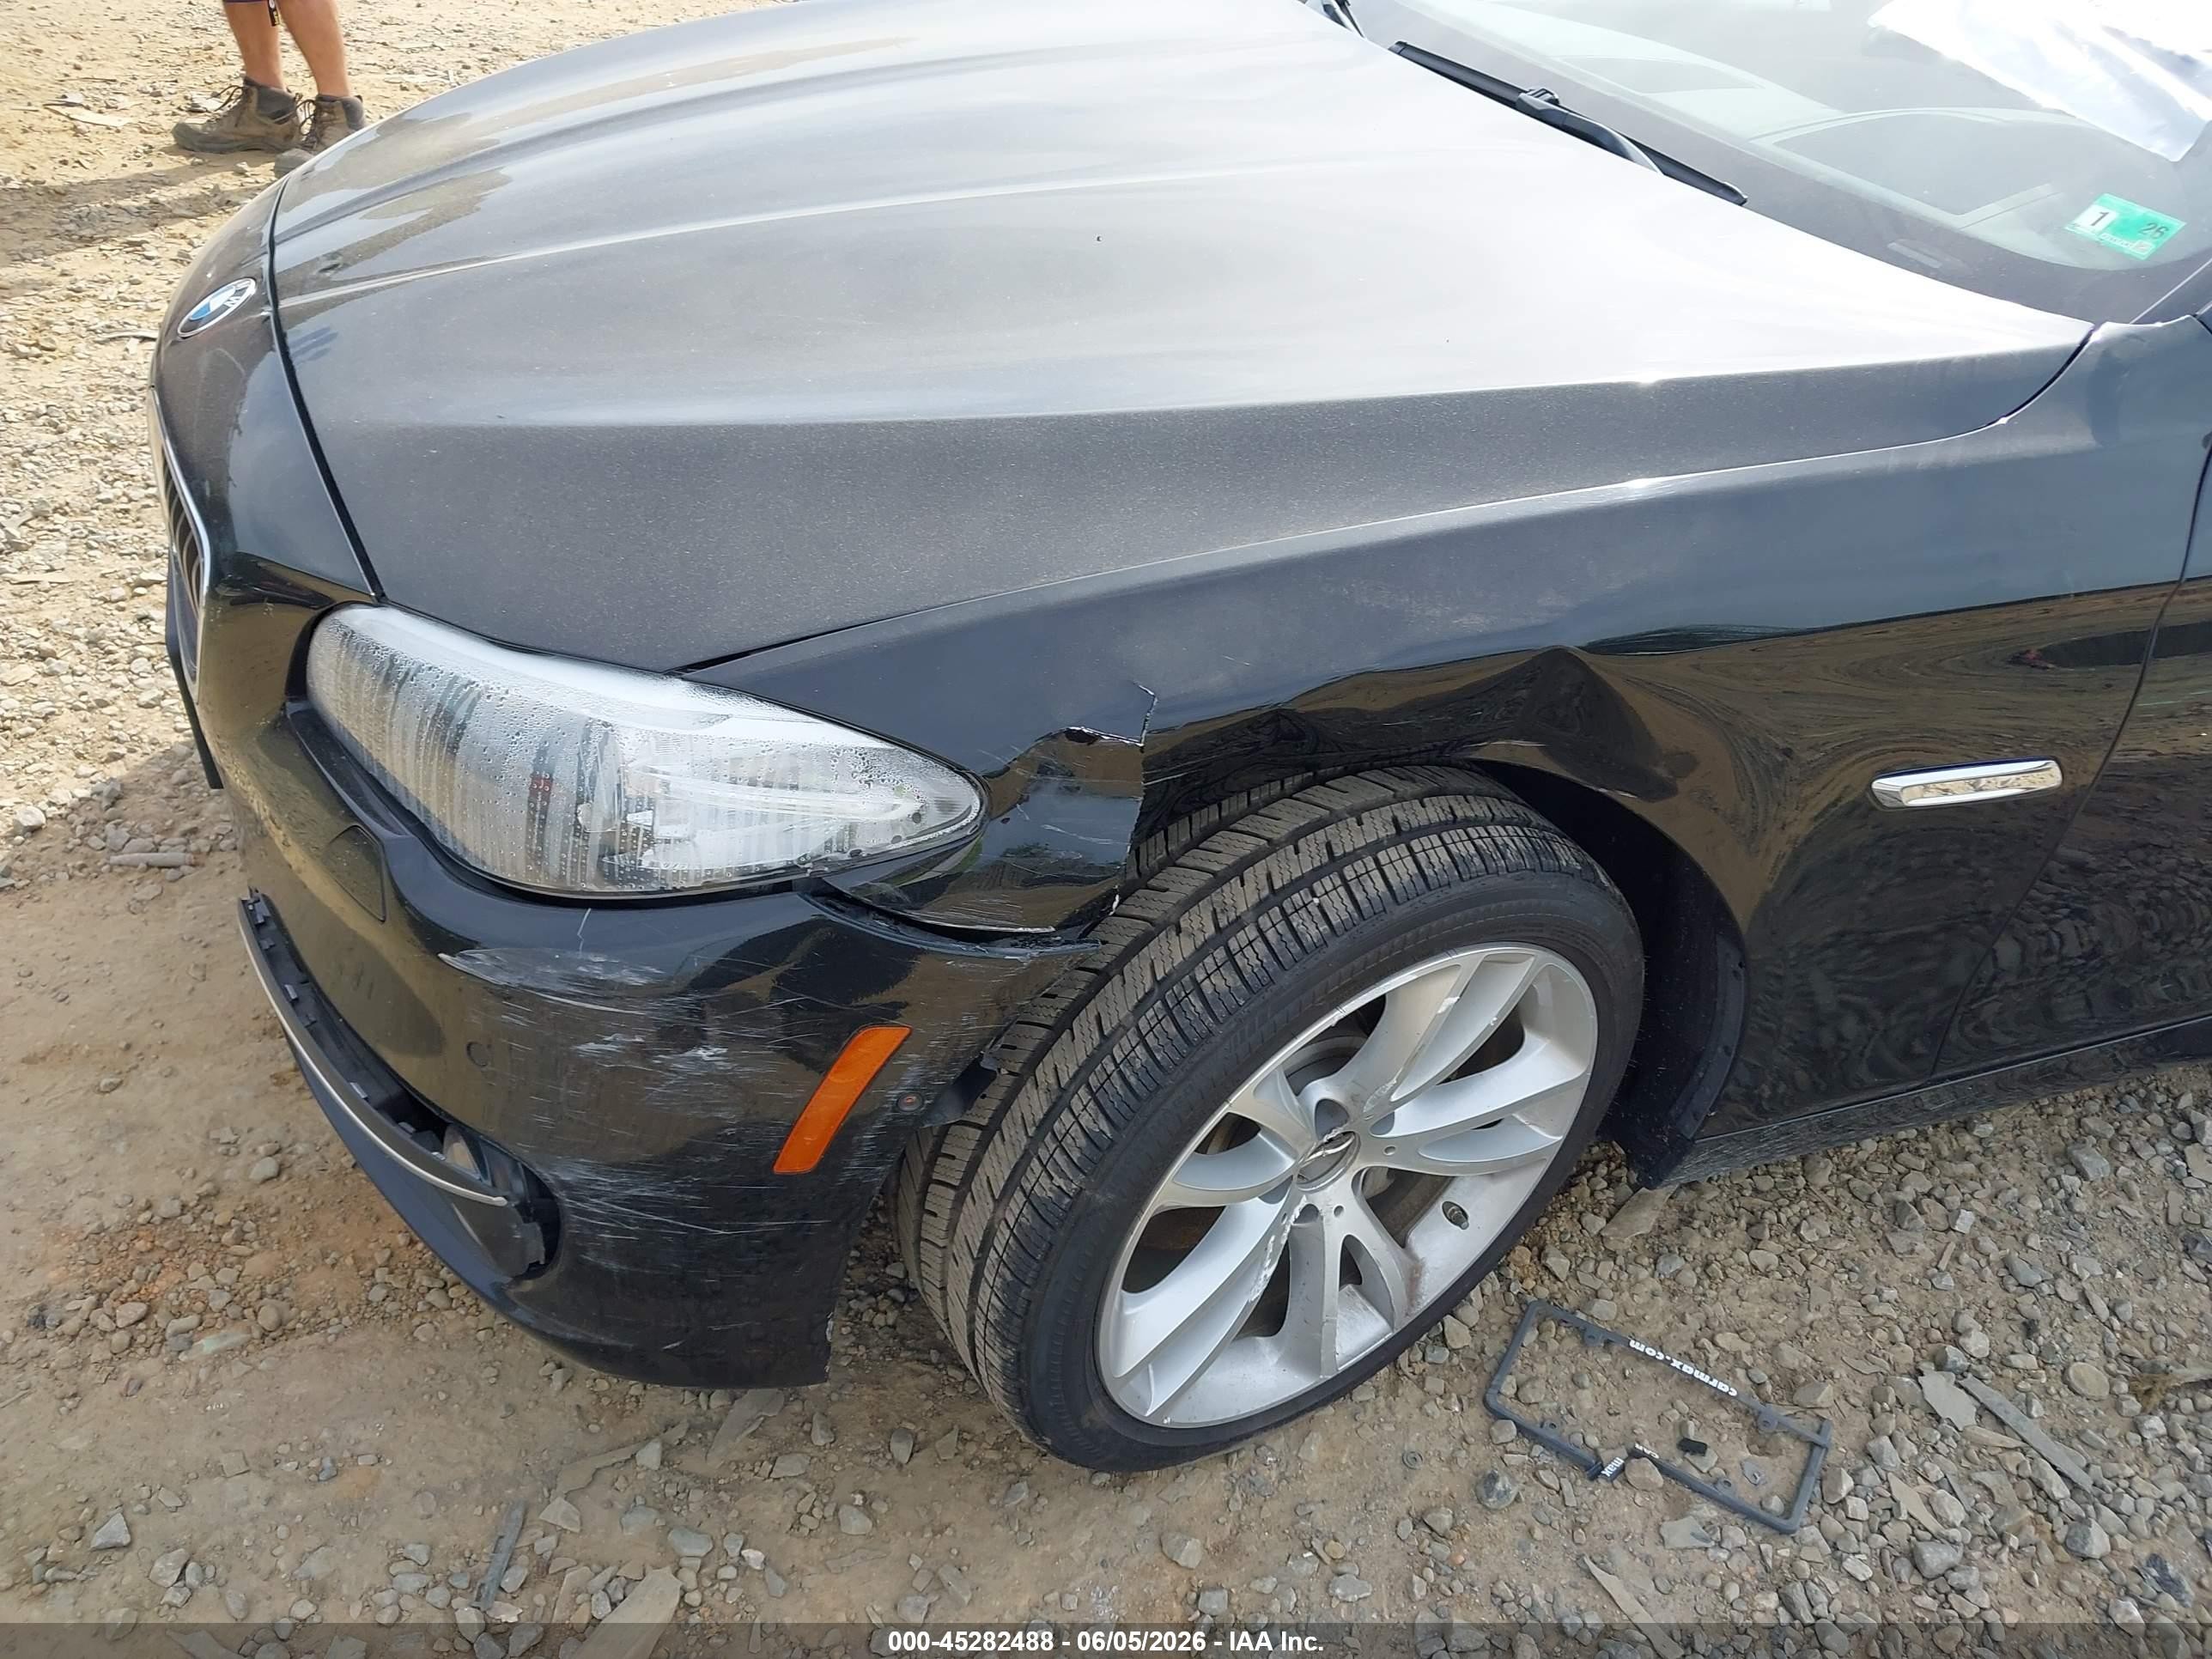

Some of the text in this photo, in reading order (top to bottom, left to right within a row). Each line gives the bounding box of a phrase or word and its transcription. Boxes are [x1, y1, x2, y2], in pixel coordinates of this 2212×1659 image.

[2090, 211, 2110, 227] 1
[2138, 222, 2170, 240] 26
[1629, 1338, 1737, 1397] carmax.com
[1601, 1456, 1626, 1478] max
